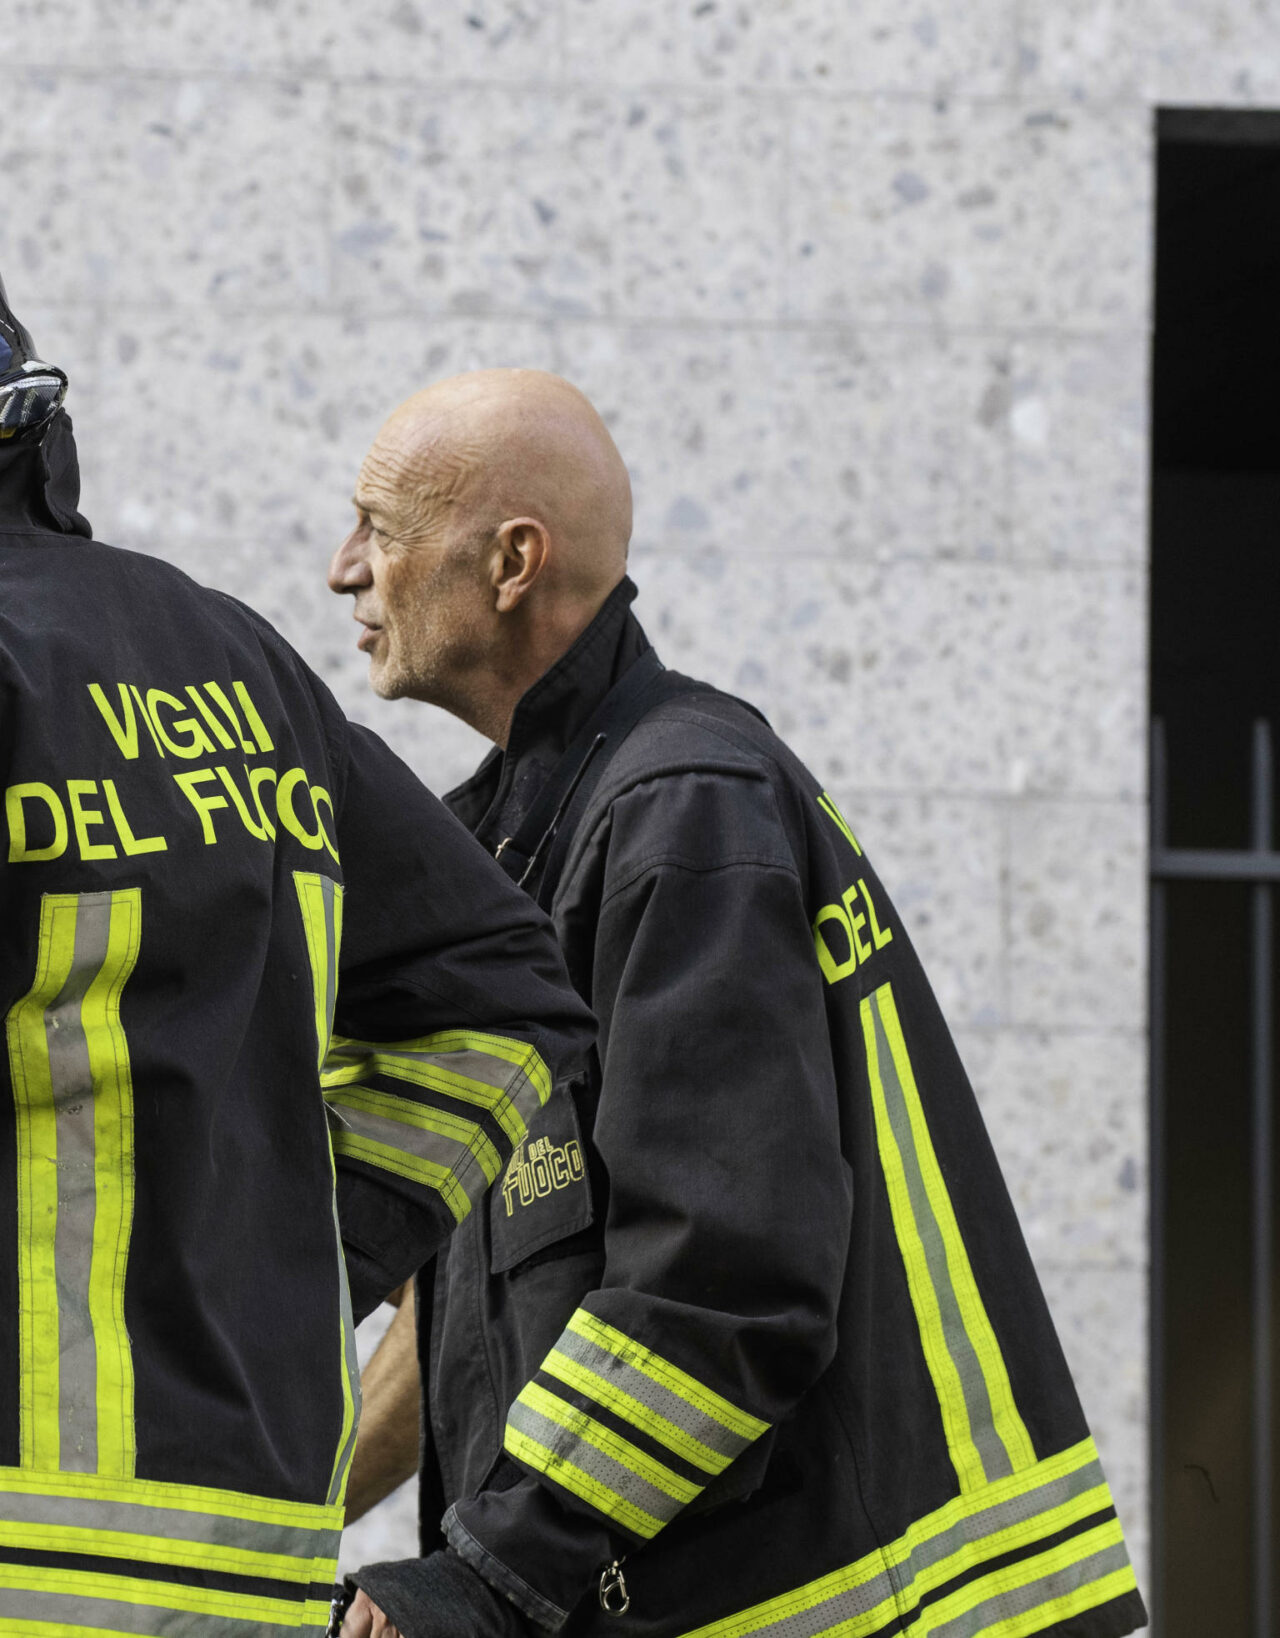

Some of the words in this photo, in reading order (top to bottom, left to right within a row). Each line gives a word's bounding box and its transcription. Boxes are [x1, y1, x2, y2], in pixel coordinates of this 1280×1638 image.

[87, 680, 275, 760] VIGILI
[5, 778, 168, 863] DEL
[812, 877, 893, 985] DEL
[502, 1139, 585, 1217] FUOCO
[527, 1135, 555, 1160] DEL
